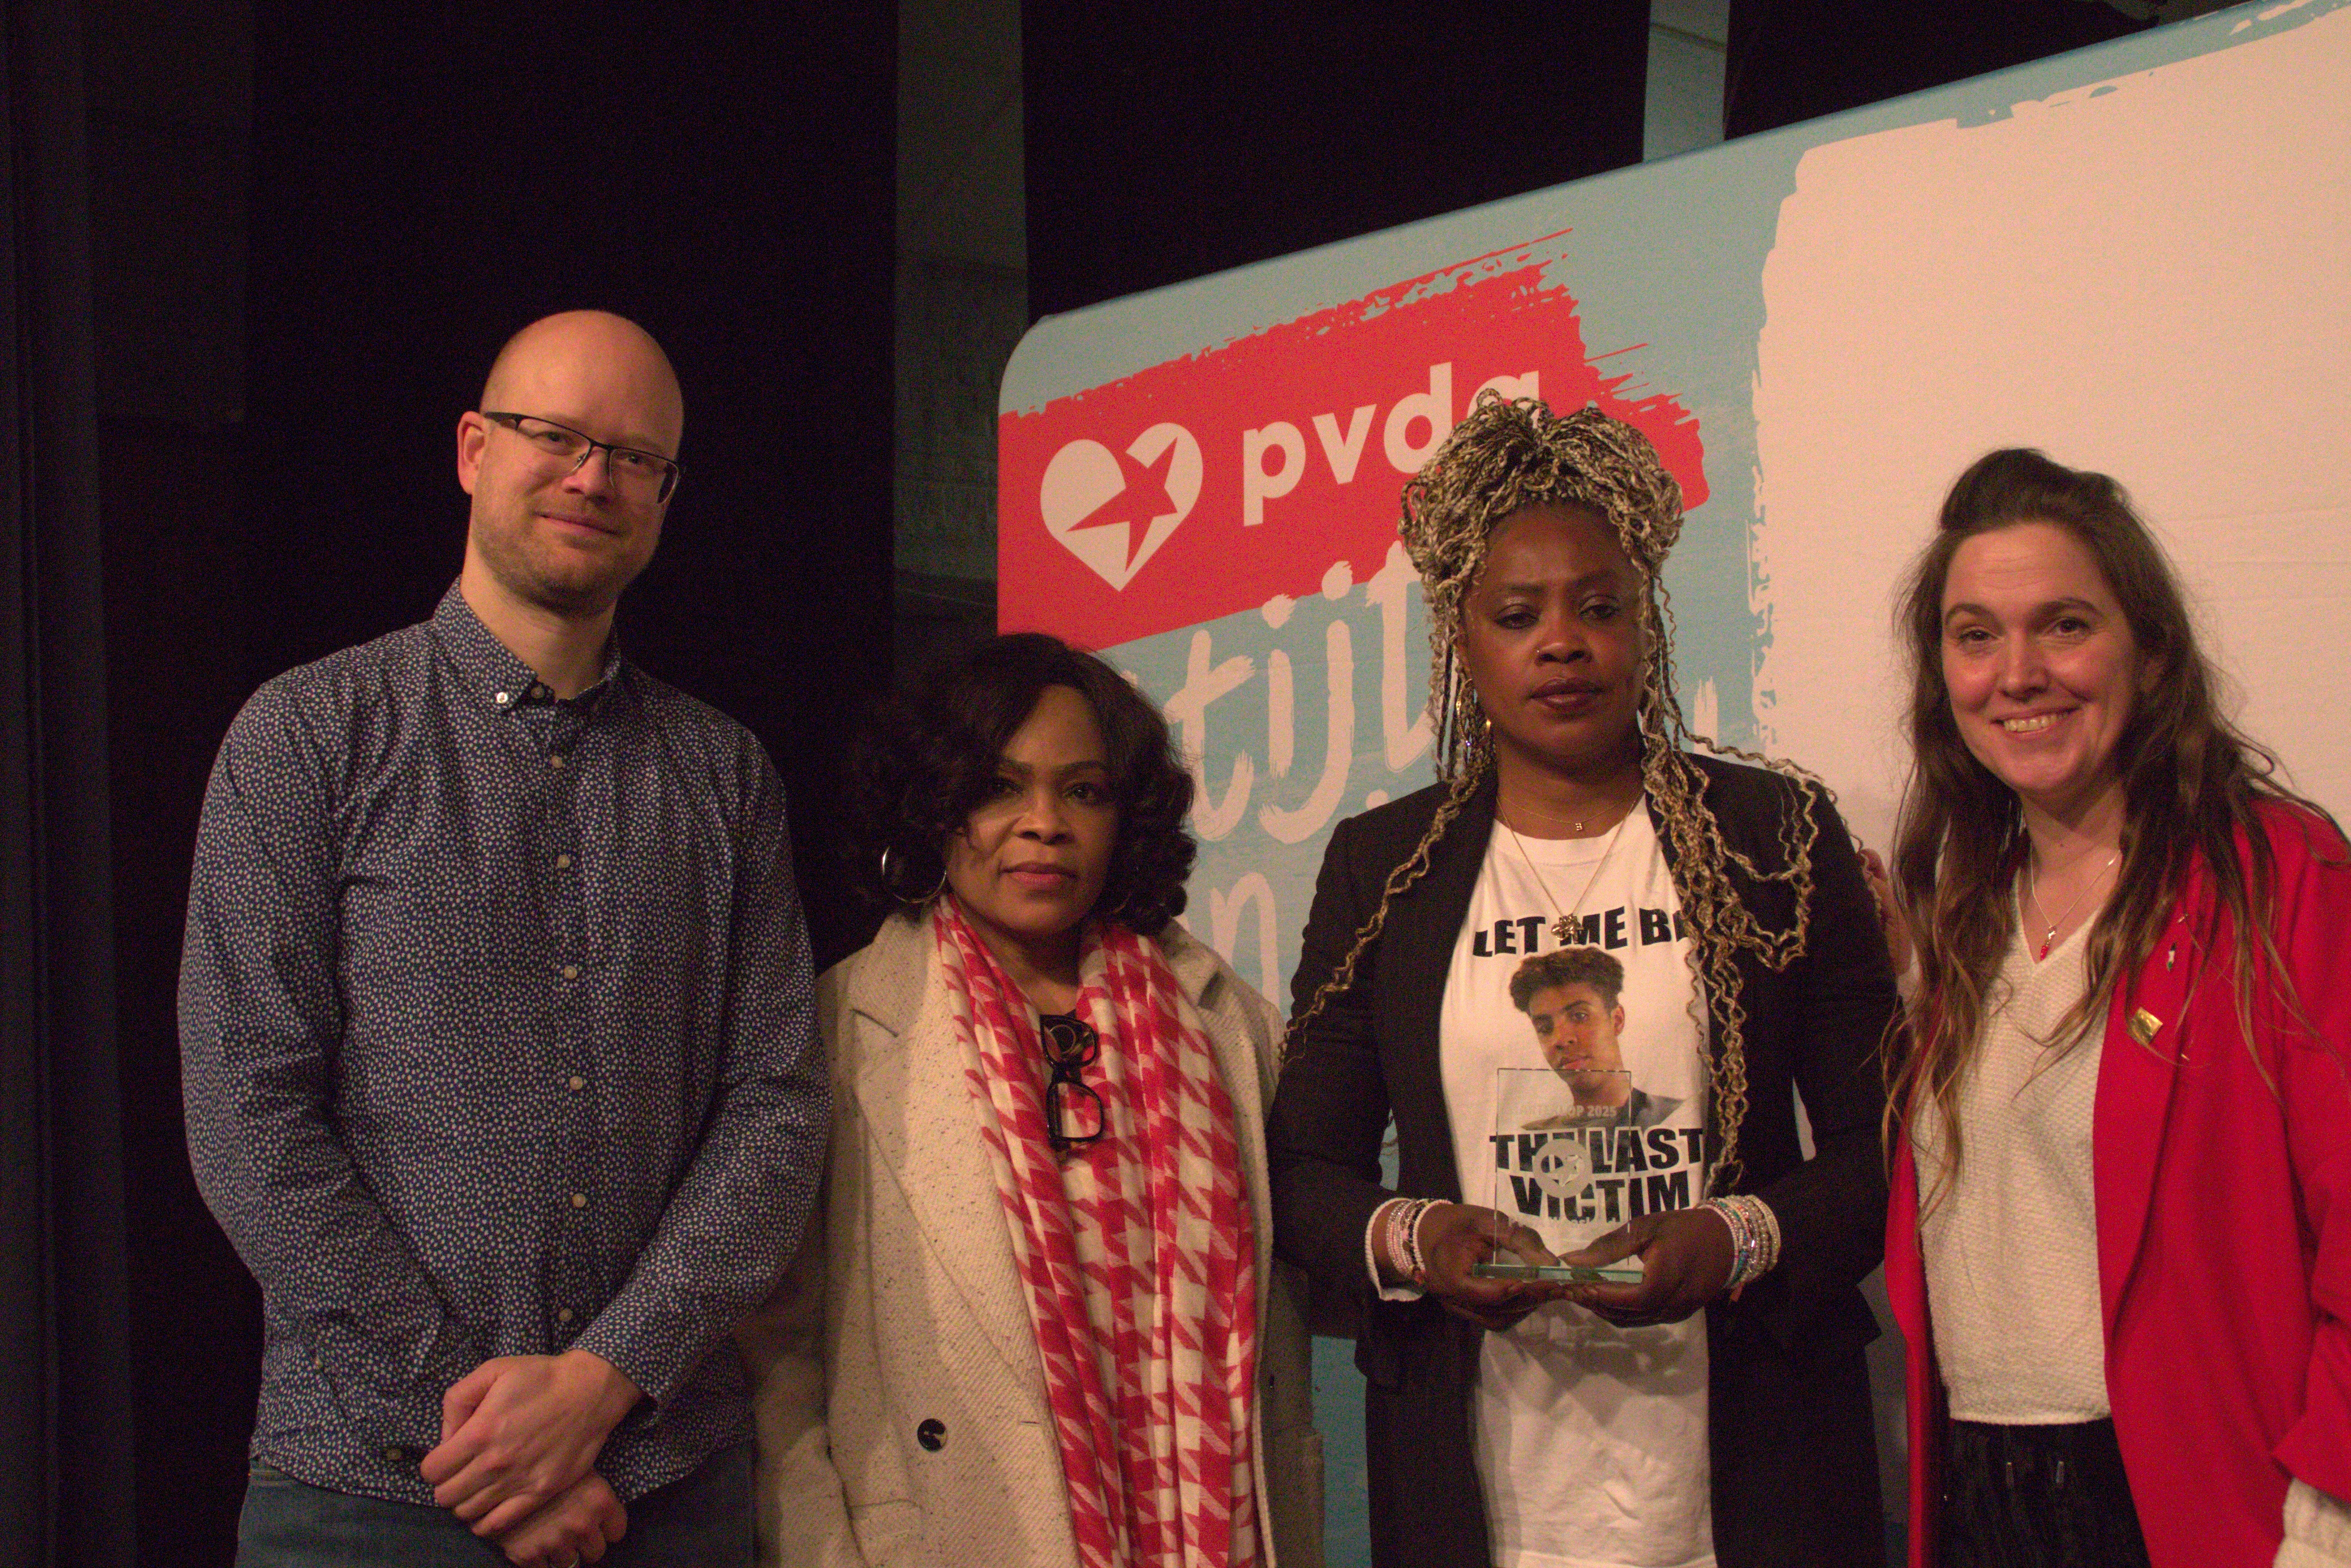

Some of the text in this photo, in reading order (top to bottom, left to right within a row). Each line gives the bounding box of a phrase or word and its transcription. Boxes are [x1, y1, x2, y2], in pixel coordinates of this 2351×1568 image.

[1472, 916, 1546, 957] LET
[1559, 906, 1628, 950] ME
[1587, 1105, 1618, 1117] 2025
[1590, 1128, 1703, 1173] LAST
[1509, 1170, 1690, 1223] VICTIM
